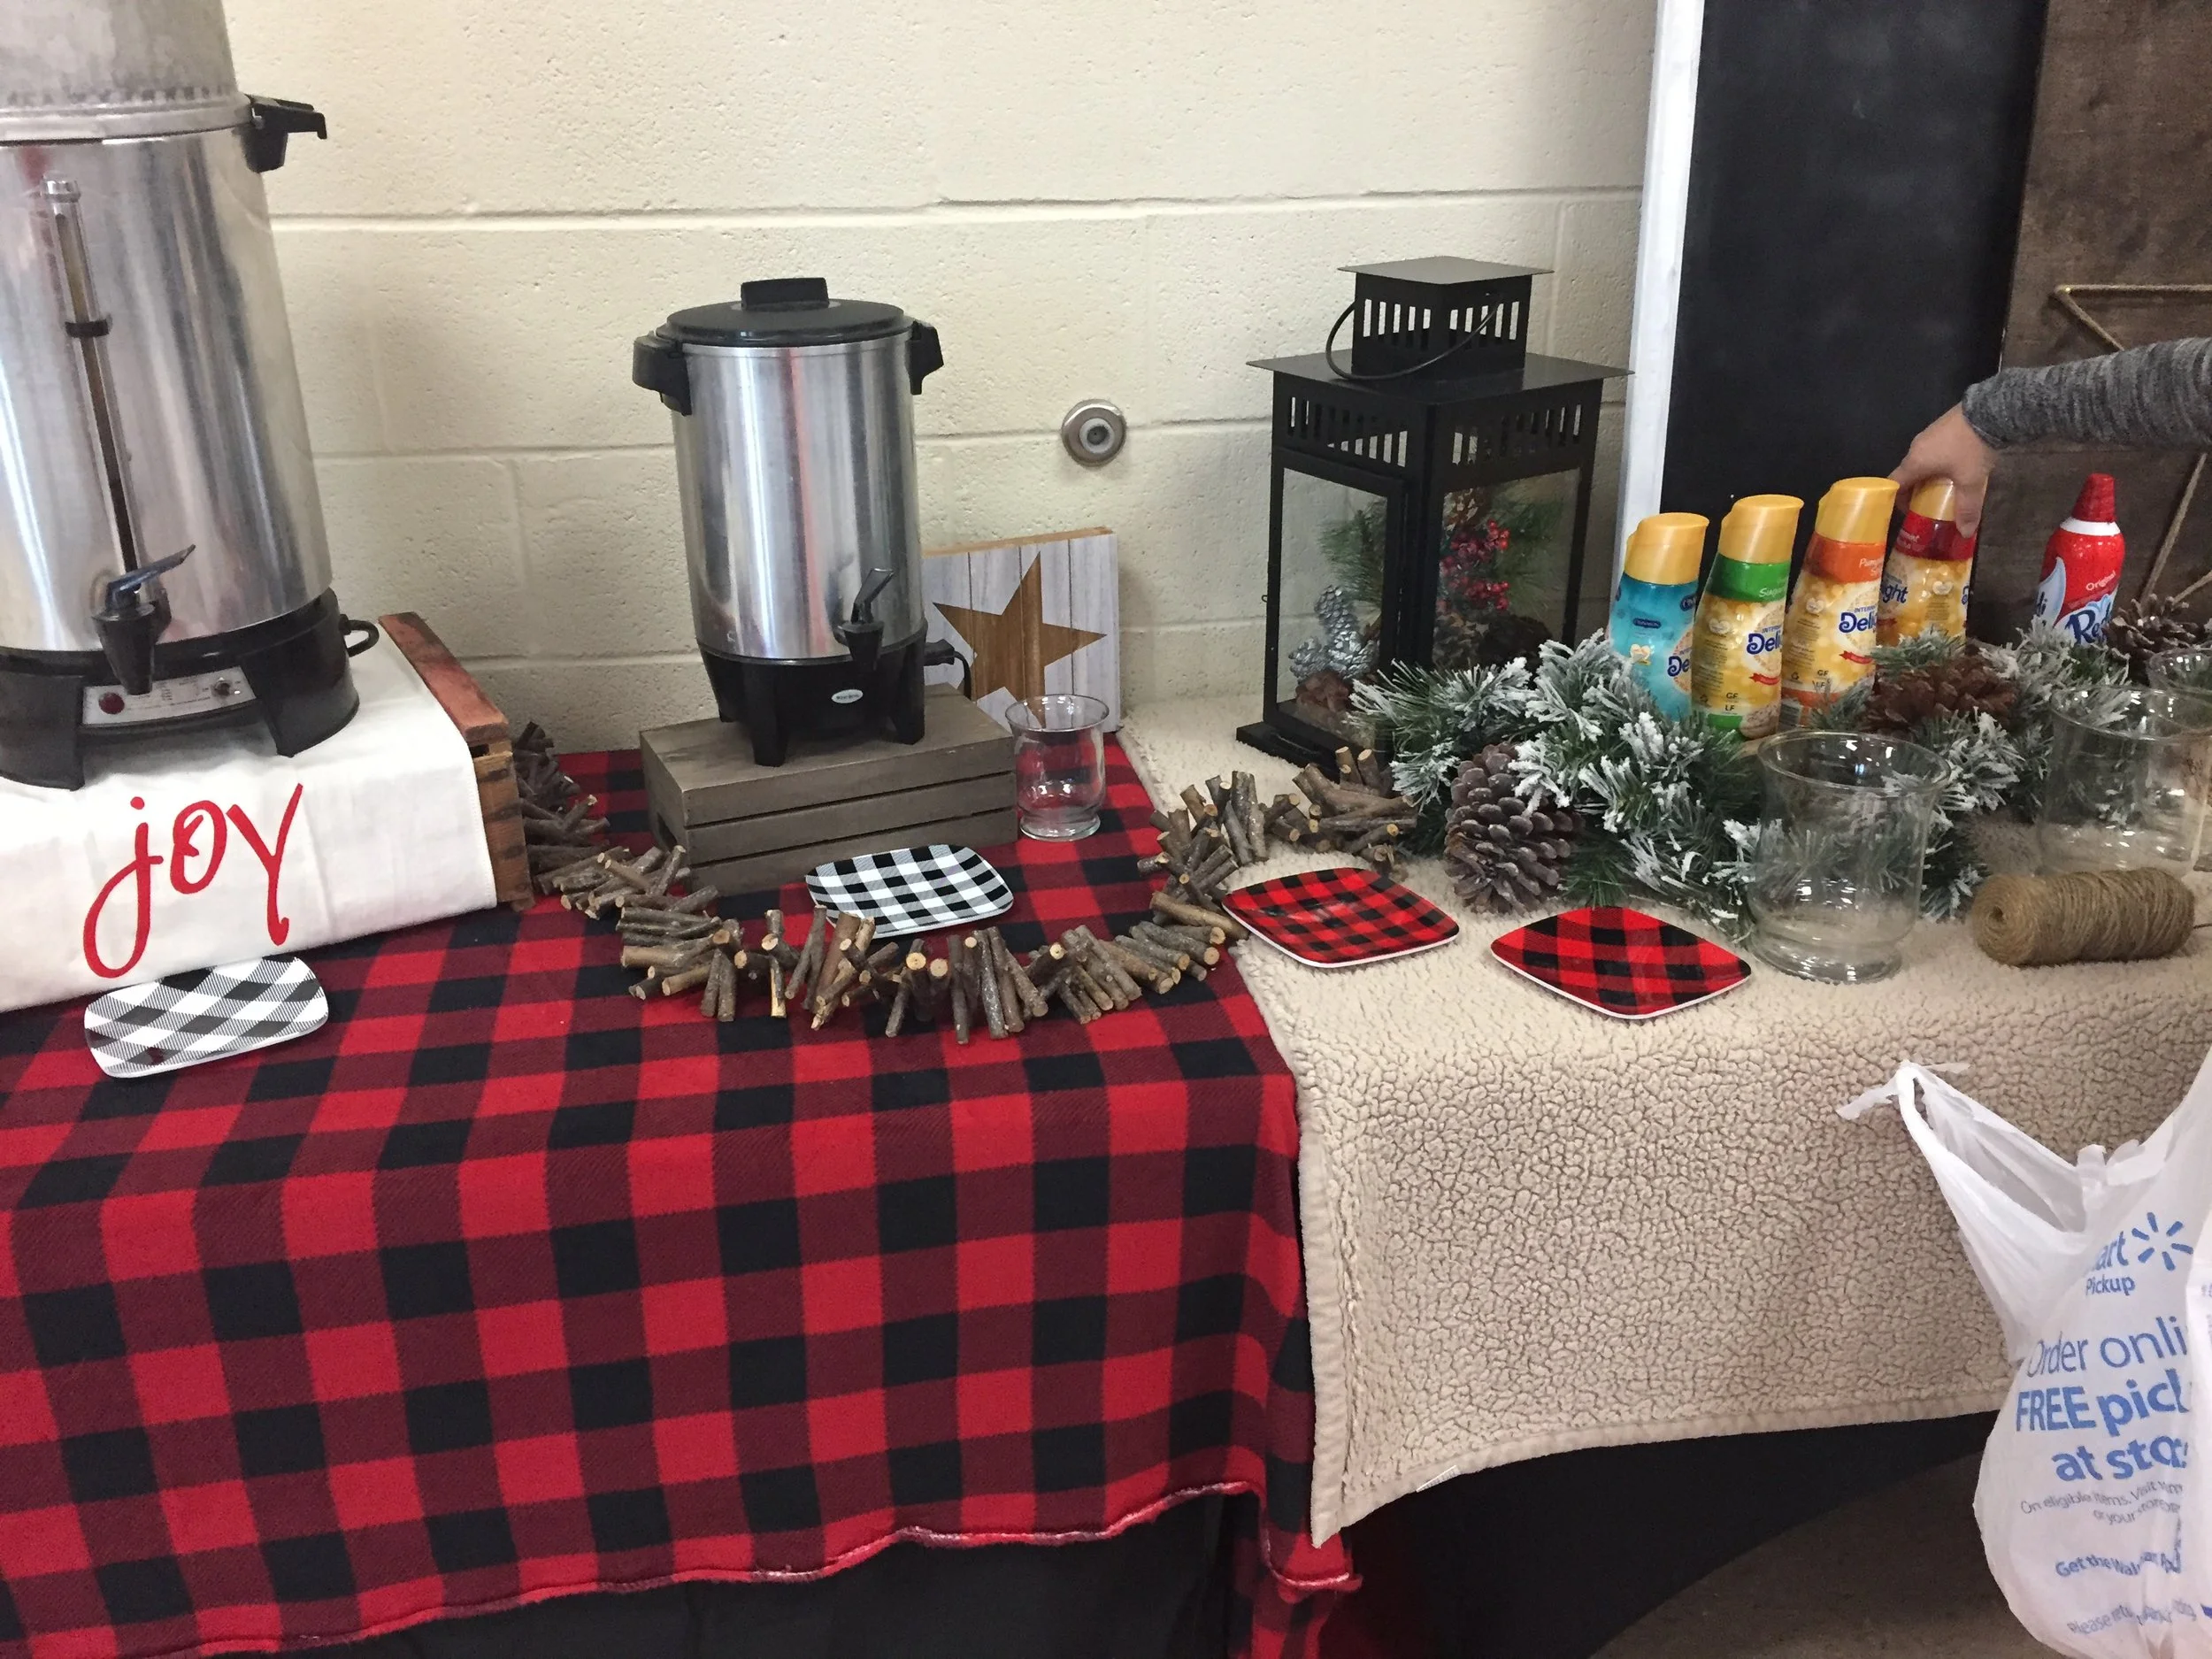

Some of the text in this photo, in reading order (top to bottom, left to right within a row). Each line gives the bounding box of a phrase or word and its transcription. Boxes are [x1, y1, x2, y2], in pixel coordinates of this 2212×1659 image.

[2085, 570, 2116, 591] Original
[2085, 1274, 2137, 1297] Pickup
[2026, 1331, 2089, 1378] Order
[2100, 1316, 2188, 1368] onli
[2016, 1386, 2097, 1432] FREE
[2051, 1445, 2104, 1482] at
[2020, 1500, 2042, 1515] On
[2043, 1490, 2093, 1509] eligible
[2131, 1480, 2157, 1501] Visit
[2105, 1512, 2136, 1526] your
[2055, 1554, 2087, 1578] Get
[2085, 1554, 2112, 1570] the
[2067, 1618, 2113, 1635] Please
